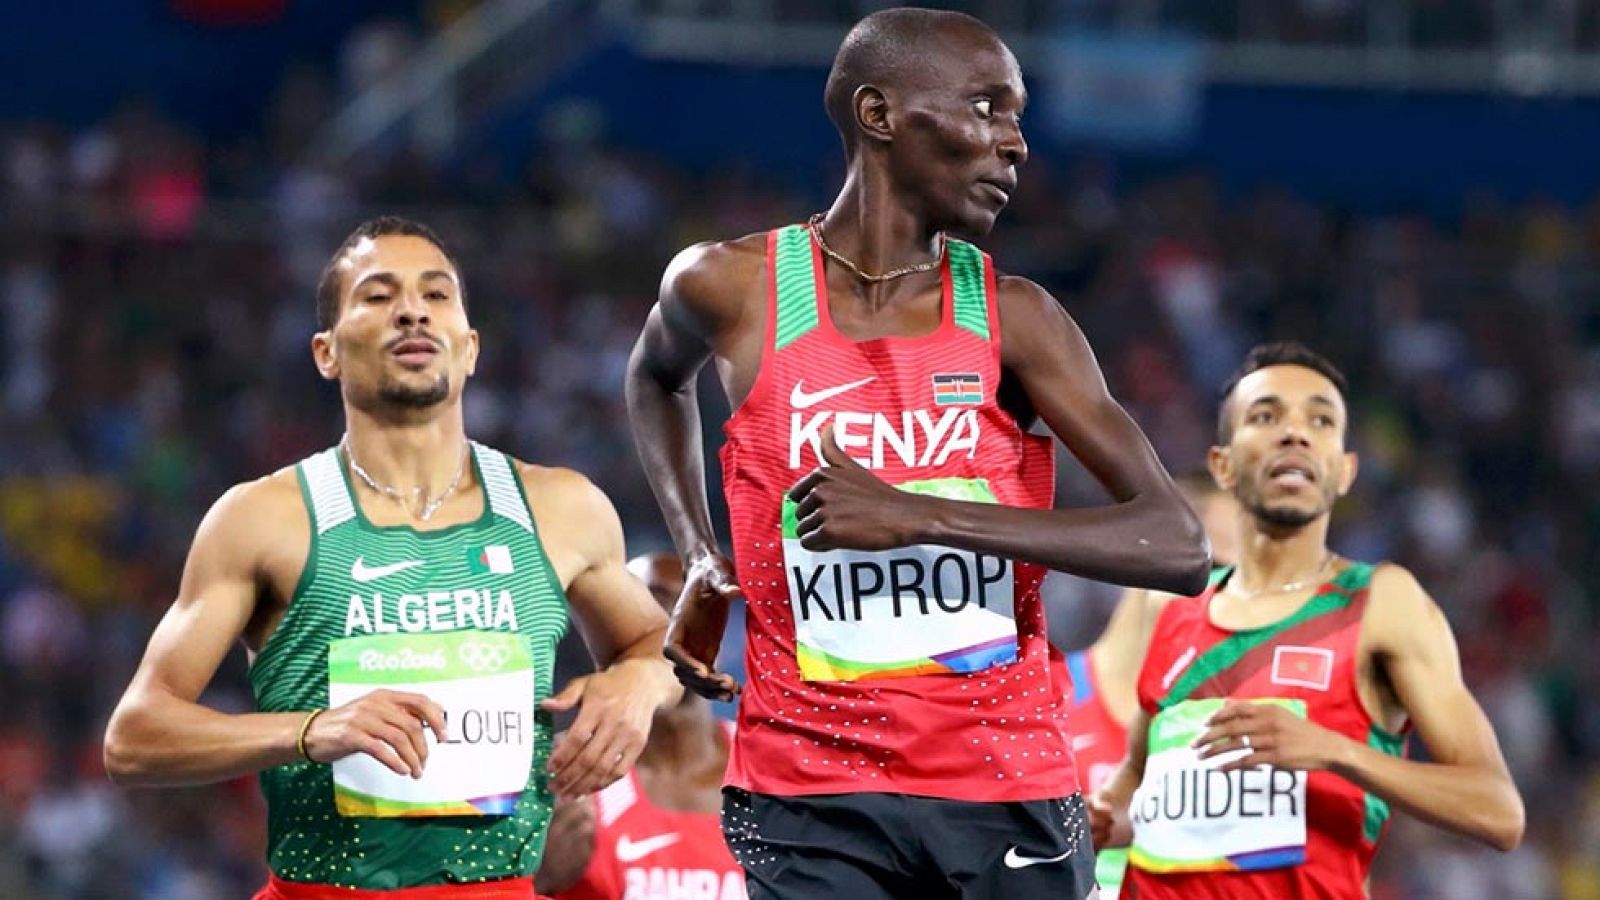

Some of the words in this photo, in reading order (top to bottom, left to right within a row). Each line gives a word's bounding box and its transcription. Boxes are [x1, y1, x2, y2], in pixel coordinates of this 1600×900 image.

[789, 408, 980, 469] KENYA
[345, 589, 518, 636] ALGERIA
[793, 551, 1007, 622] KIPROP
[421, 709, 522, 744] LOUFI
[1134, 767, 1298, 824] GUIDER
